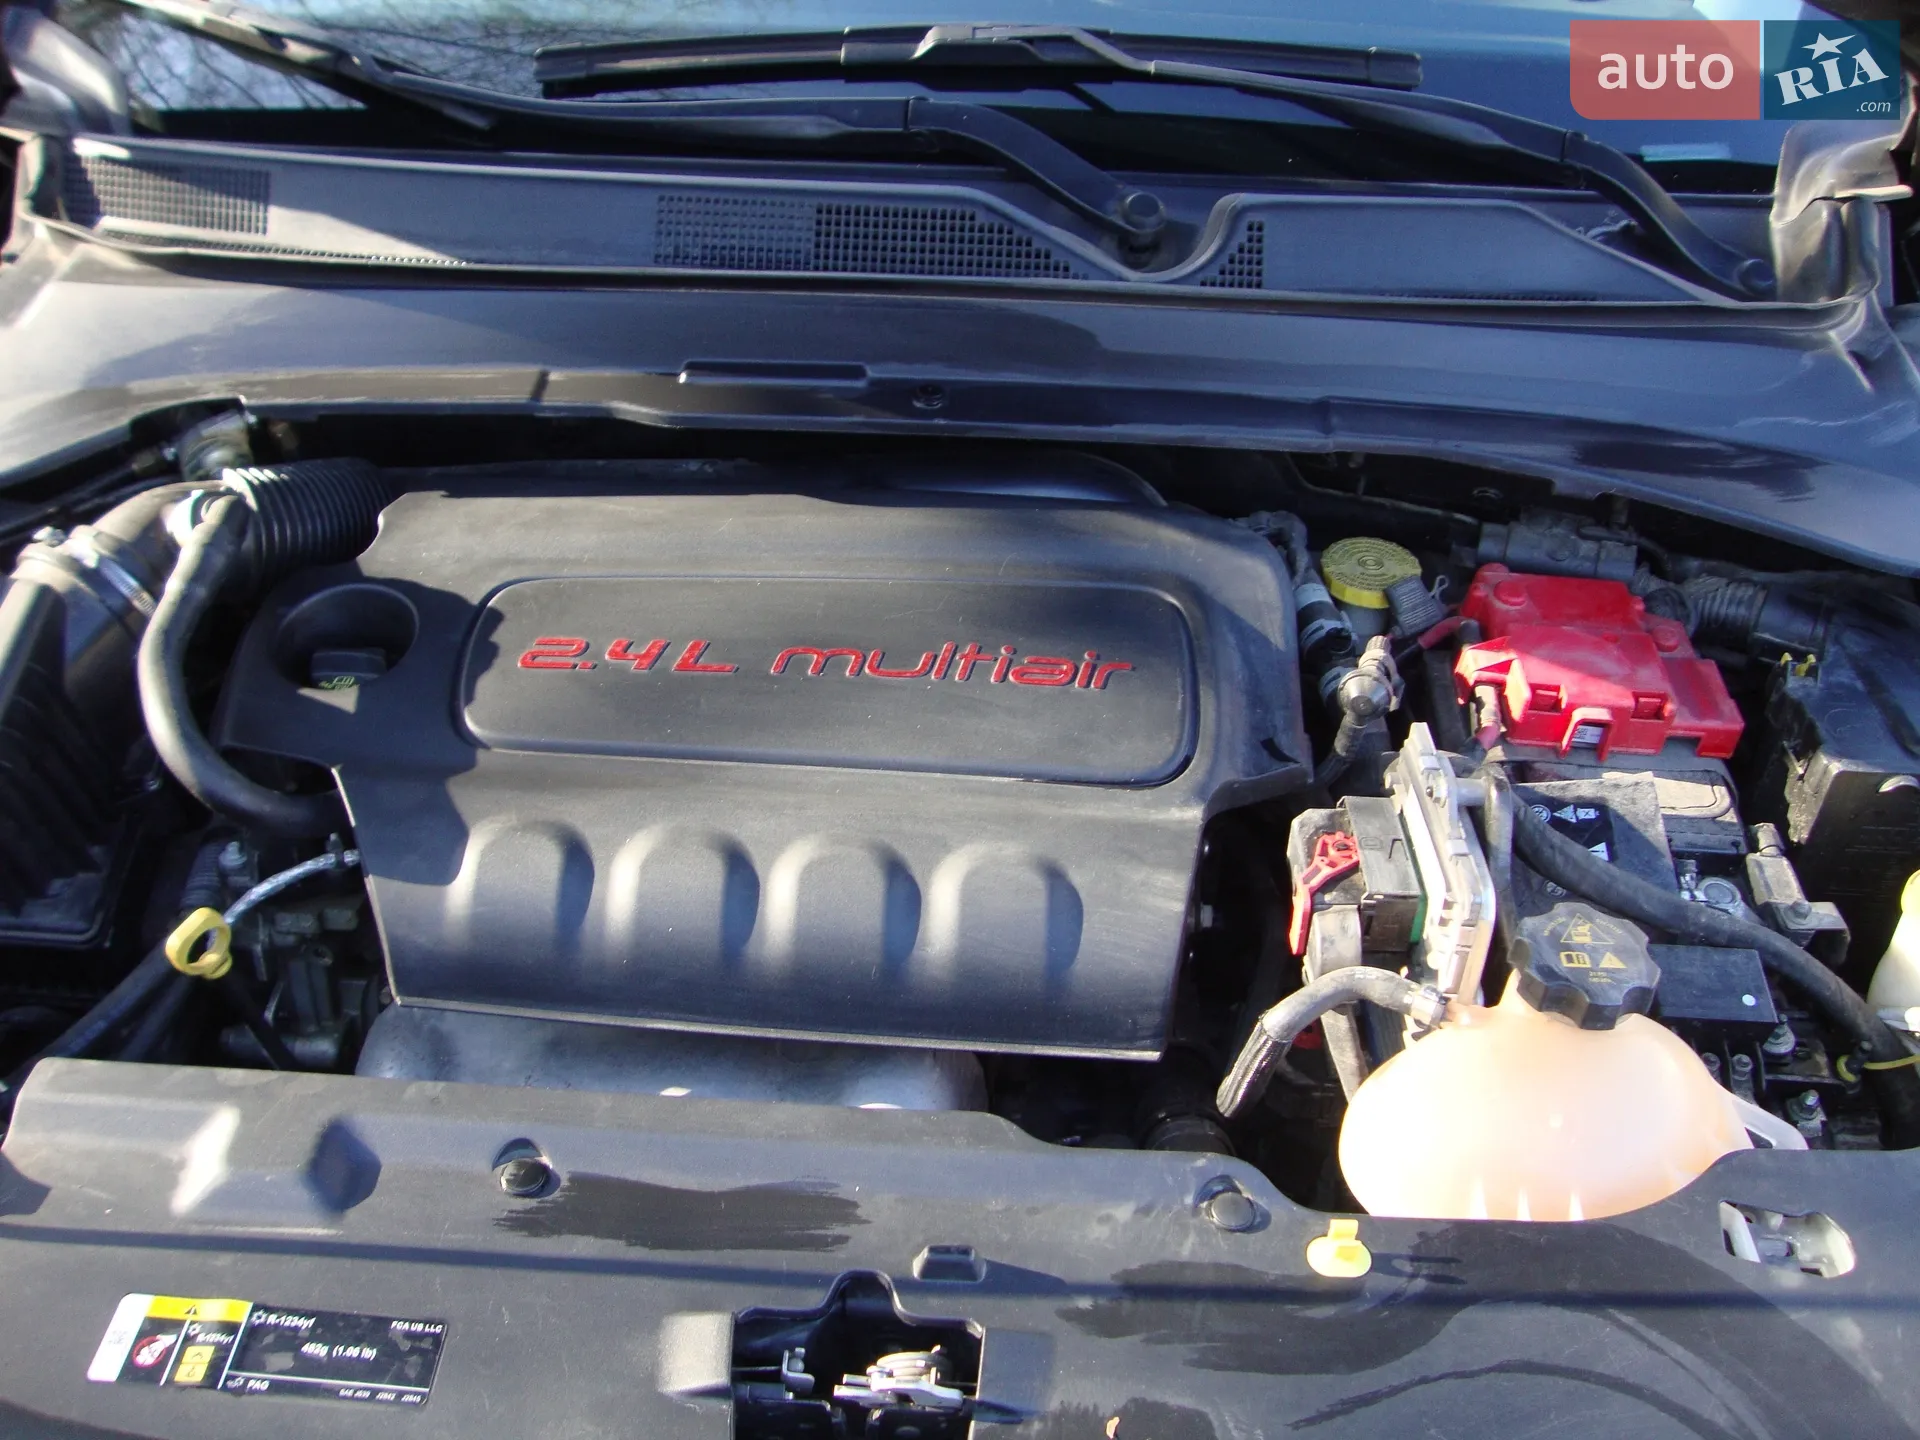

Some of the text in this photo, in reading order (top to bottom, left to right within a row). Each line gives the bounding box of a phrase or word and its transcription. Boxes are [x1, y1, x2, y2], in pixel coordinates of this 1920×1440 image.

[769, 640, 1137, 691] multiair
[265, 1313, 317, 1330] R-1234yf
[424, 1323, 443, 1334] LLC
